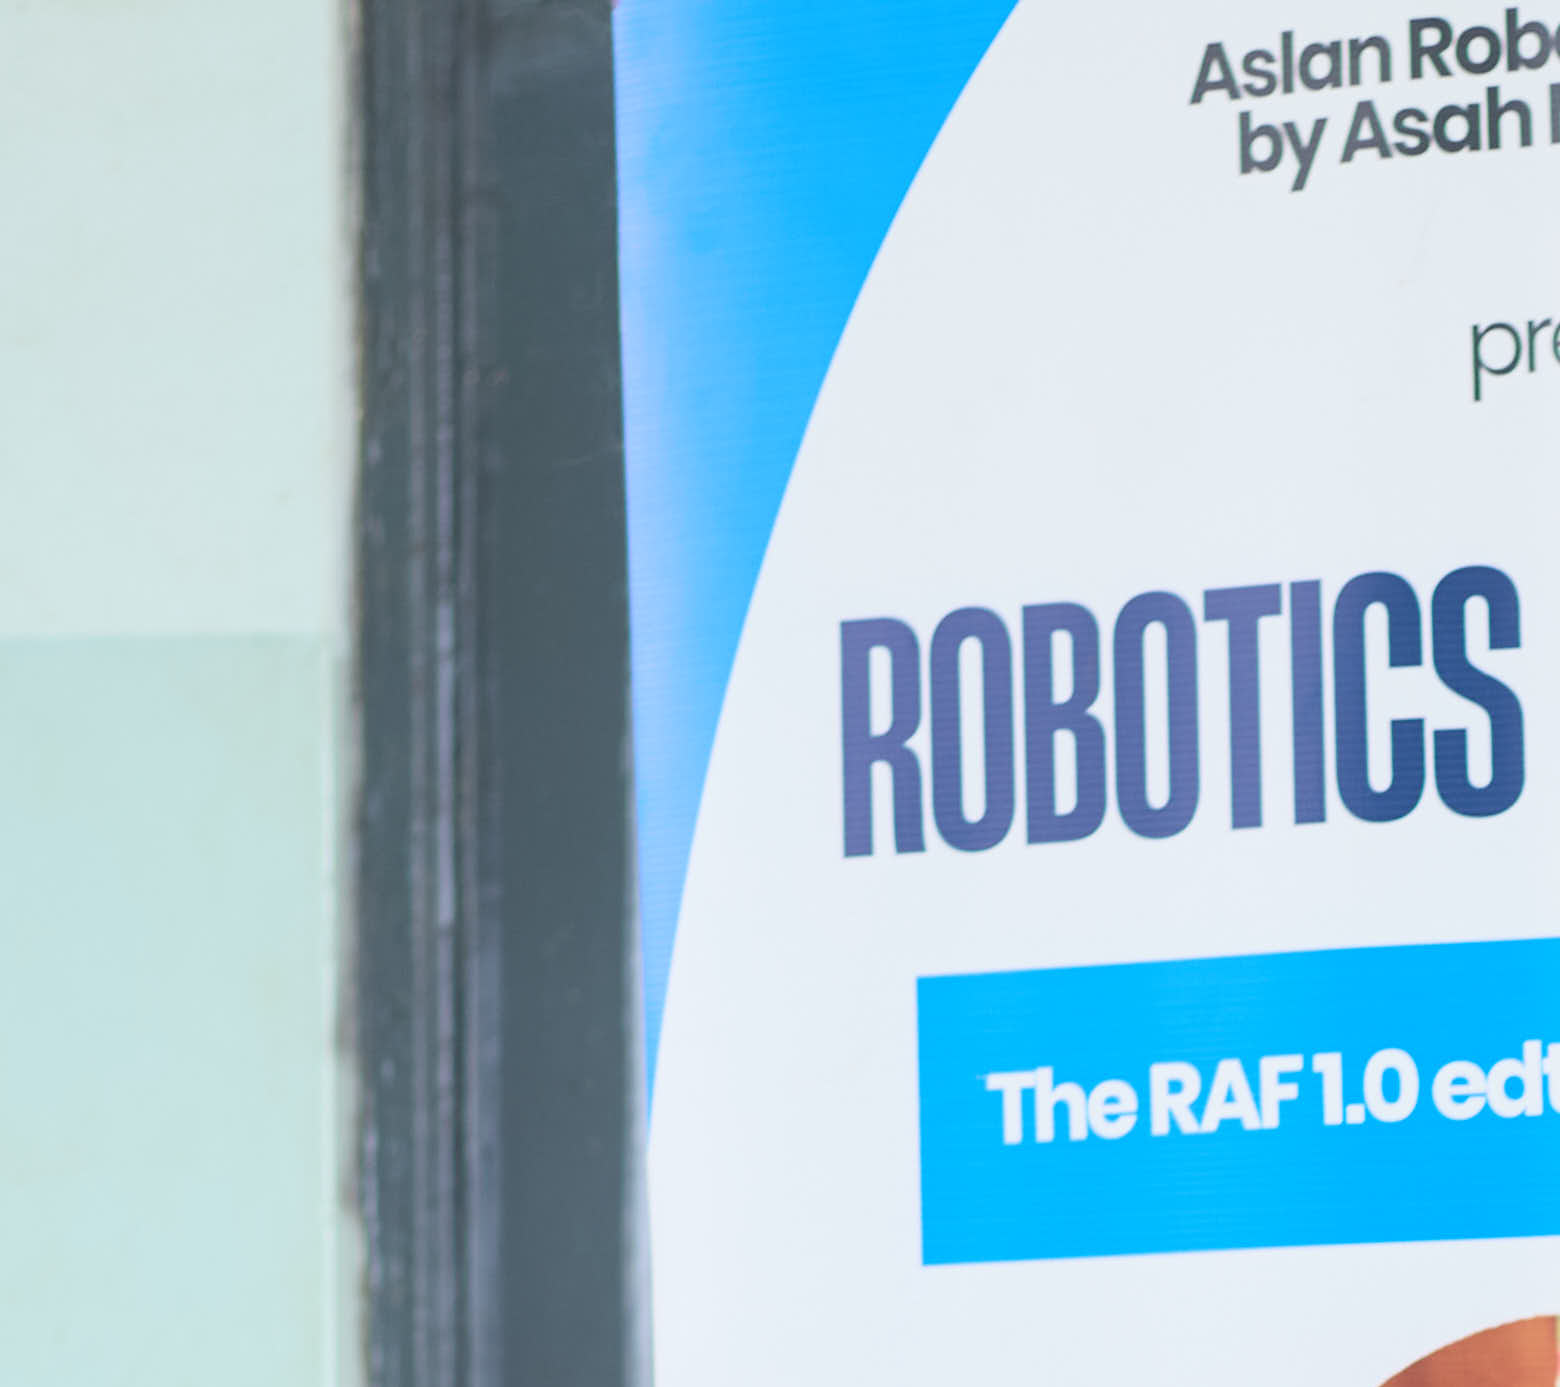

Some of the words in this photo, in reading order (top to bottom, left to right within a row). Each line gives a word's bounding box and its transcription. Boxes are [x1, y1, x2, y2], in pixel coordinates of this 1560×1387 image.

[1189, 30, 1392, 105] Aslan
[1238, 110, 1329, 192] by
[1339, 86, 1534, 164] Asah
[839, 564, 1527, 859] ROBOTICS
[985, 1065, 1139, 1146] The
[1149, 1053, 1304, 1137] RAF
[1311, 1047, 1420, 1126] 1.0
